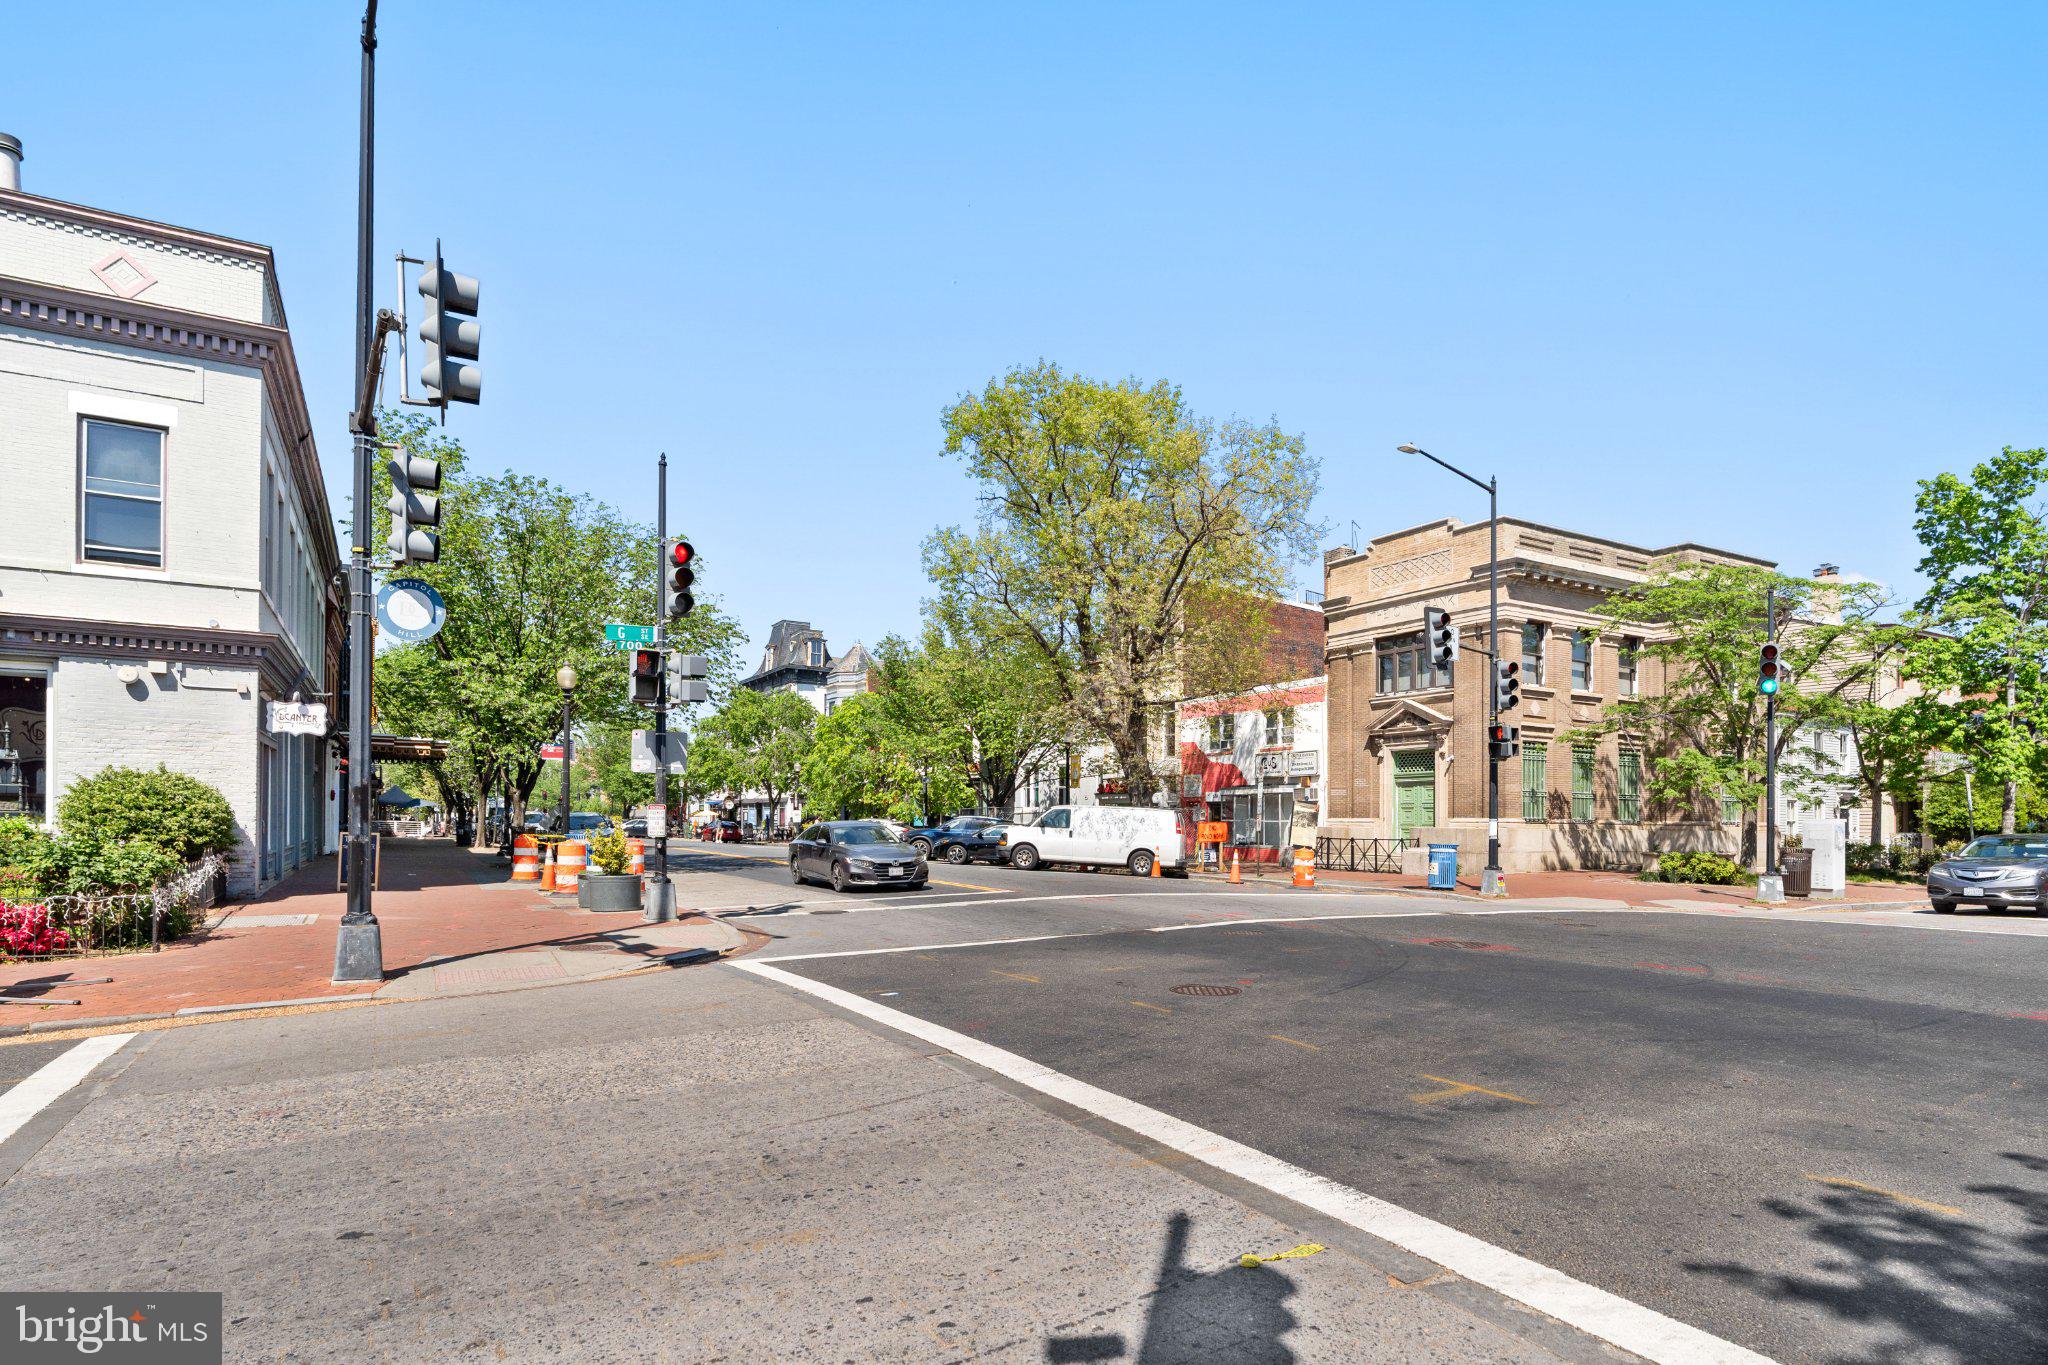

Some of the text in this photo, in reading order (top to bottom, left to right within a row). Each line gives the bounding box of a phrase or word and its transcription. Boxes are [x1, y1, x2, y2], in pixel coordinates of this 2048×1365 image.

[388, 581, 432, 596] CAPITOL
[398, 629, 424, 638] HILL
[617, 627, 625, 638] G
[620, 640, 643, 650] 700
